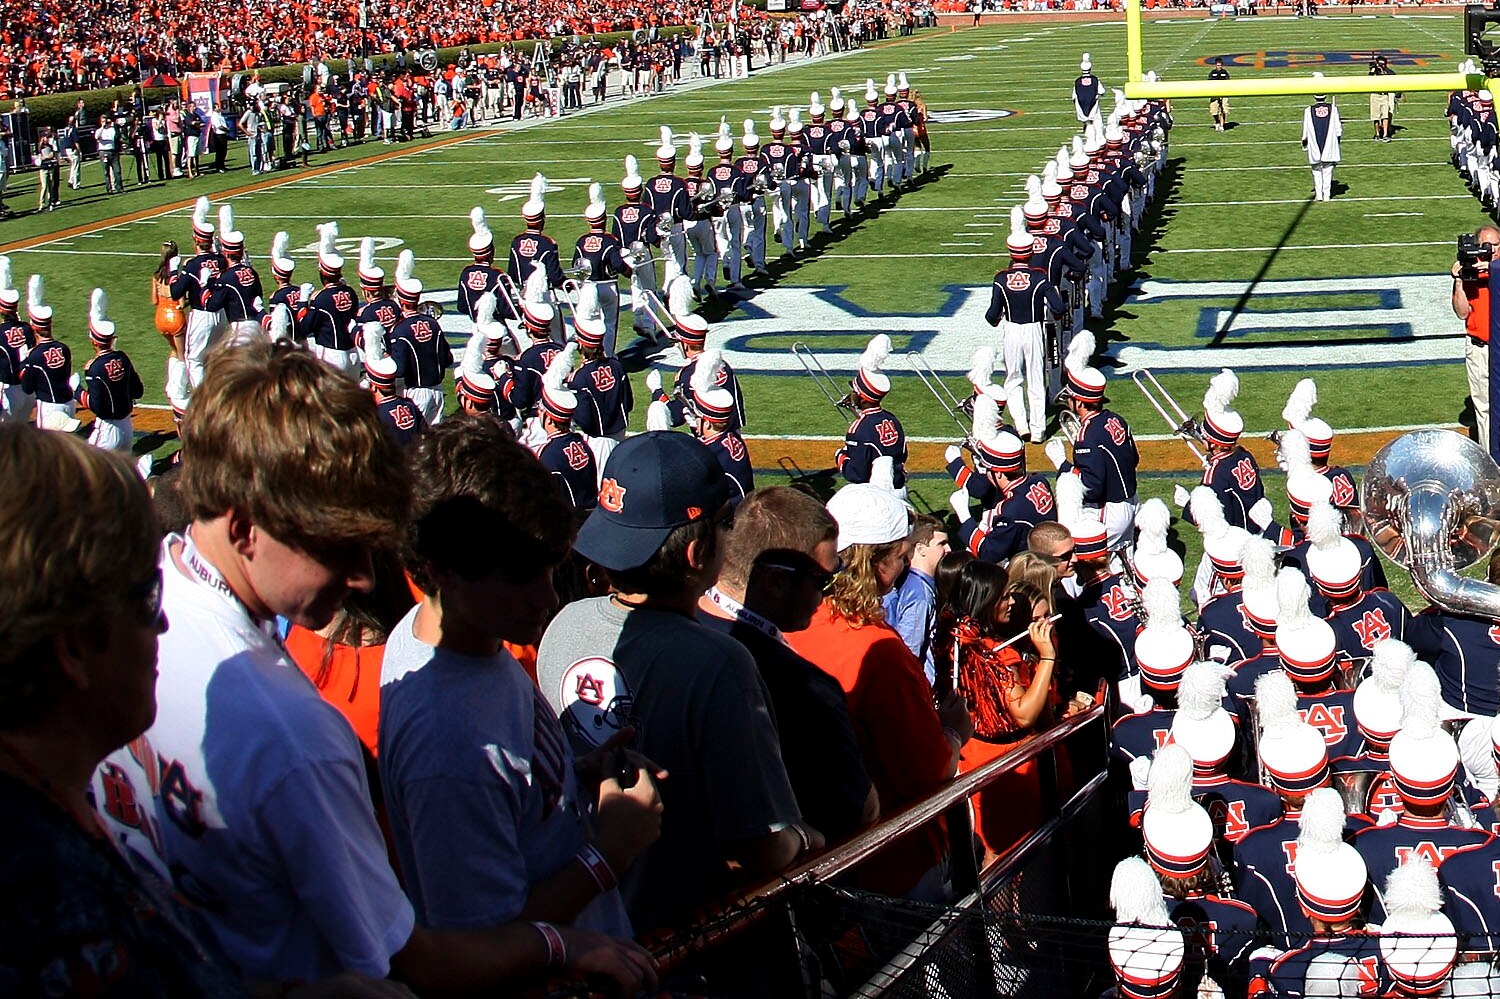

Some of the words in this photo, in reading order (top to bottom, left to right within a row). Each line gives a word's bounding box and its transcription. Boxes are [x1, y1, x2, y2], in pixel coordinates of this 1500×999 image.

[769, 144, 785, 158] AU
[715, 166, 732, 180] AU
[742, 159, 759, 173] AU
[654, 177, 672, 193] AU
[1070, 184, 1089, 200] AU
[622, 206, 640, 224] AU
[1043, 217, 1061, 235] AU
[519, 238, 539, 257] AU
[584, 235, 603, 252] AU
[235, 267, 255, 287] AU
[468, 271, 488, 290] AU
[1006, 271, 1031, 291] AU
[332, 290, 352, 312] AU
[375, 305, 397, 327] AU
[5, 326, 26, 348] AU
[410, 320, 433, 343] AU
[43, 347, 66, 369] AU
[104, 358, 125, 381] AU
[590, 366, 617, 392] AU
[389, 404, 415, 429] AU
[875, 418, 899, 447] AU
[1103, 416, 1127, 446] AU
[563, 441, 591, 470] AU
[721, 431, 745, 462] AU
[1231, 457, 1257, 490] AU
[600, 477, 628, 513] AU
[1025, 481, 1053, 515] AU
[1352, 607, 1393, 650] AU
[575, 672, 605, 706] AU
